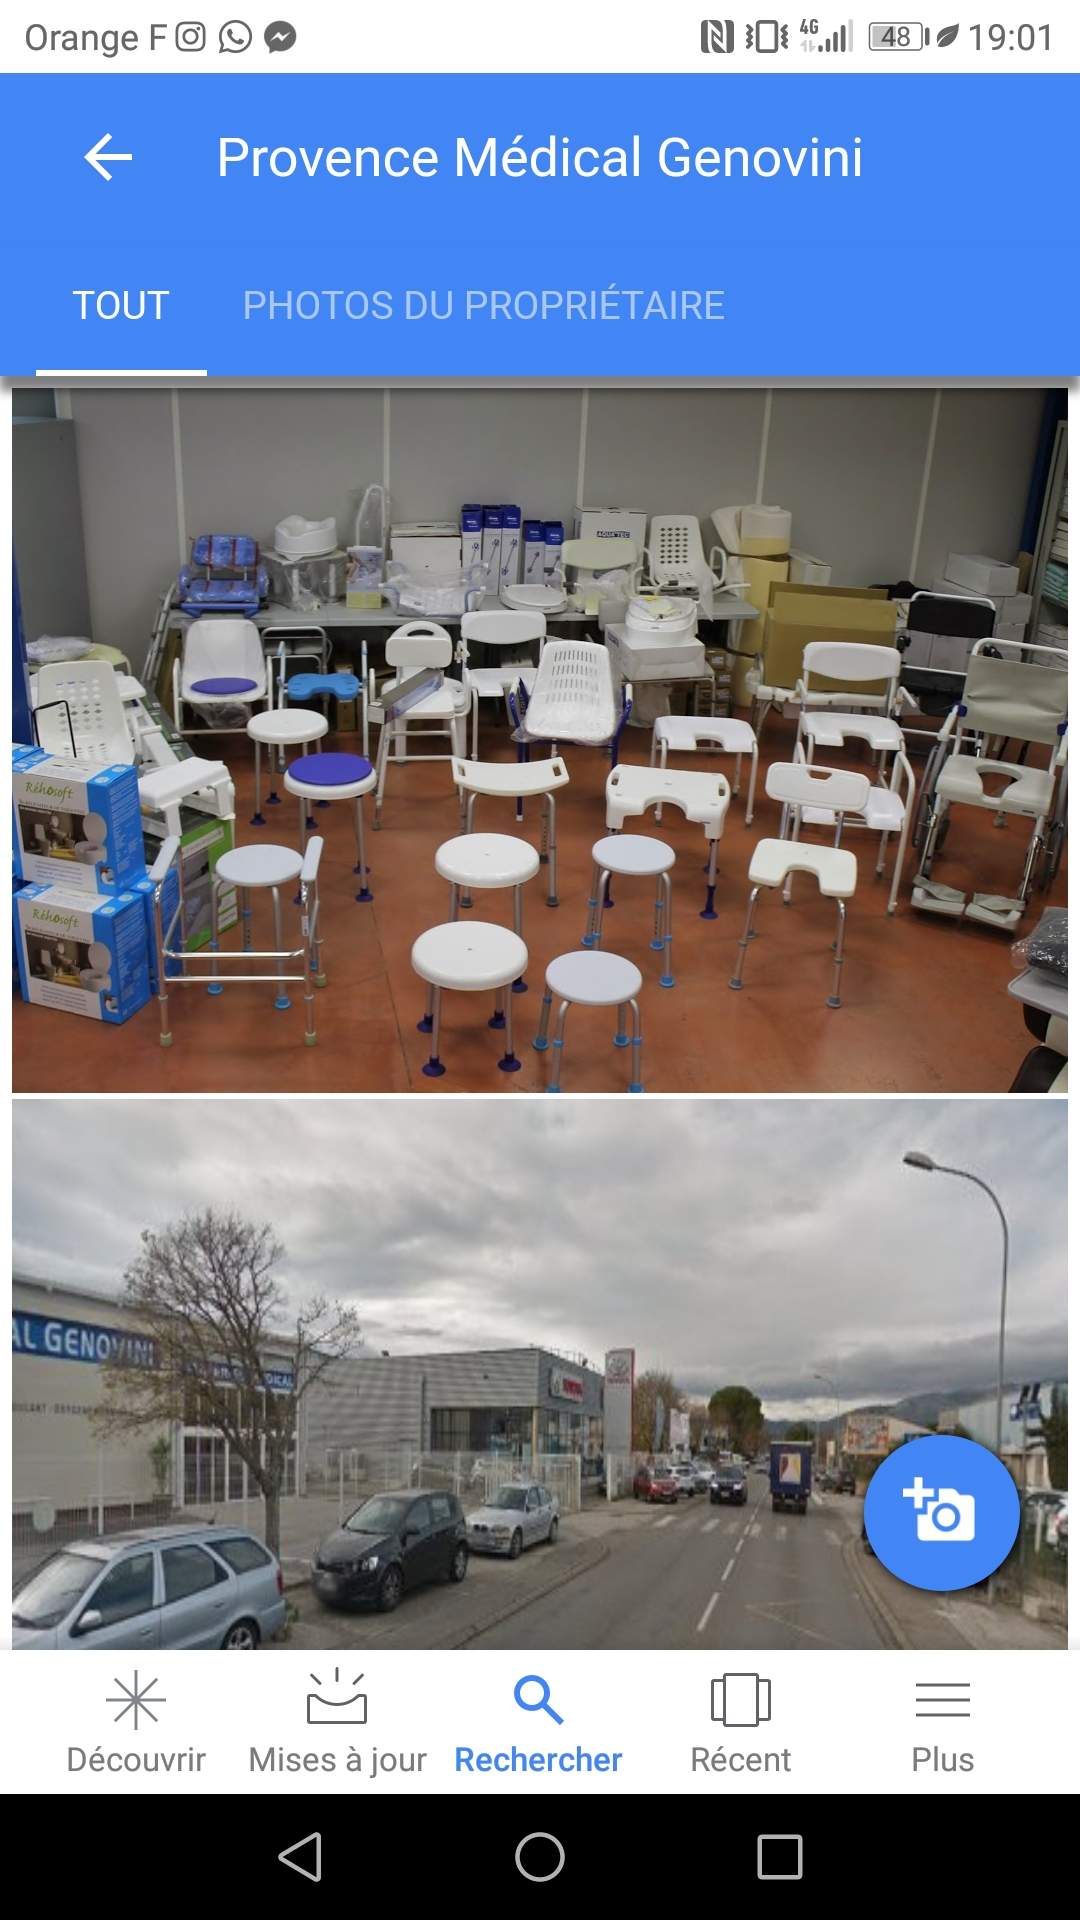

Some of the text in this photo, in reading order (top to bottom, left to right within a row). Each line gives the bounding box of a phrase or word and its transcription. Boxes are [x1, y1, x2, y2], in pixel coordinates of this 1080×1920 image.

[24, 23, 168, 59] Orange F
[799, 18, 820, 35] 4G
[880, 25, 911, 48] 48
[969, 23, 1050, 52] 19:01
[218, 132, 862, 178] Provence Médical Genovini
[71, 287, 170, 321] TOUT
[244, 282, 725, 321] PHOTOS DU PROPRIÉTAIRE
[67, 1744, 207, 1773] Découvrir
[249, 1745, 428, 1779] Mises à jour
[455, 1744, 624, 1773] Rechercher
[691, 1745, 792, 1773] Récent
[912, 1745, 975, 1773] Plus
